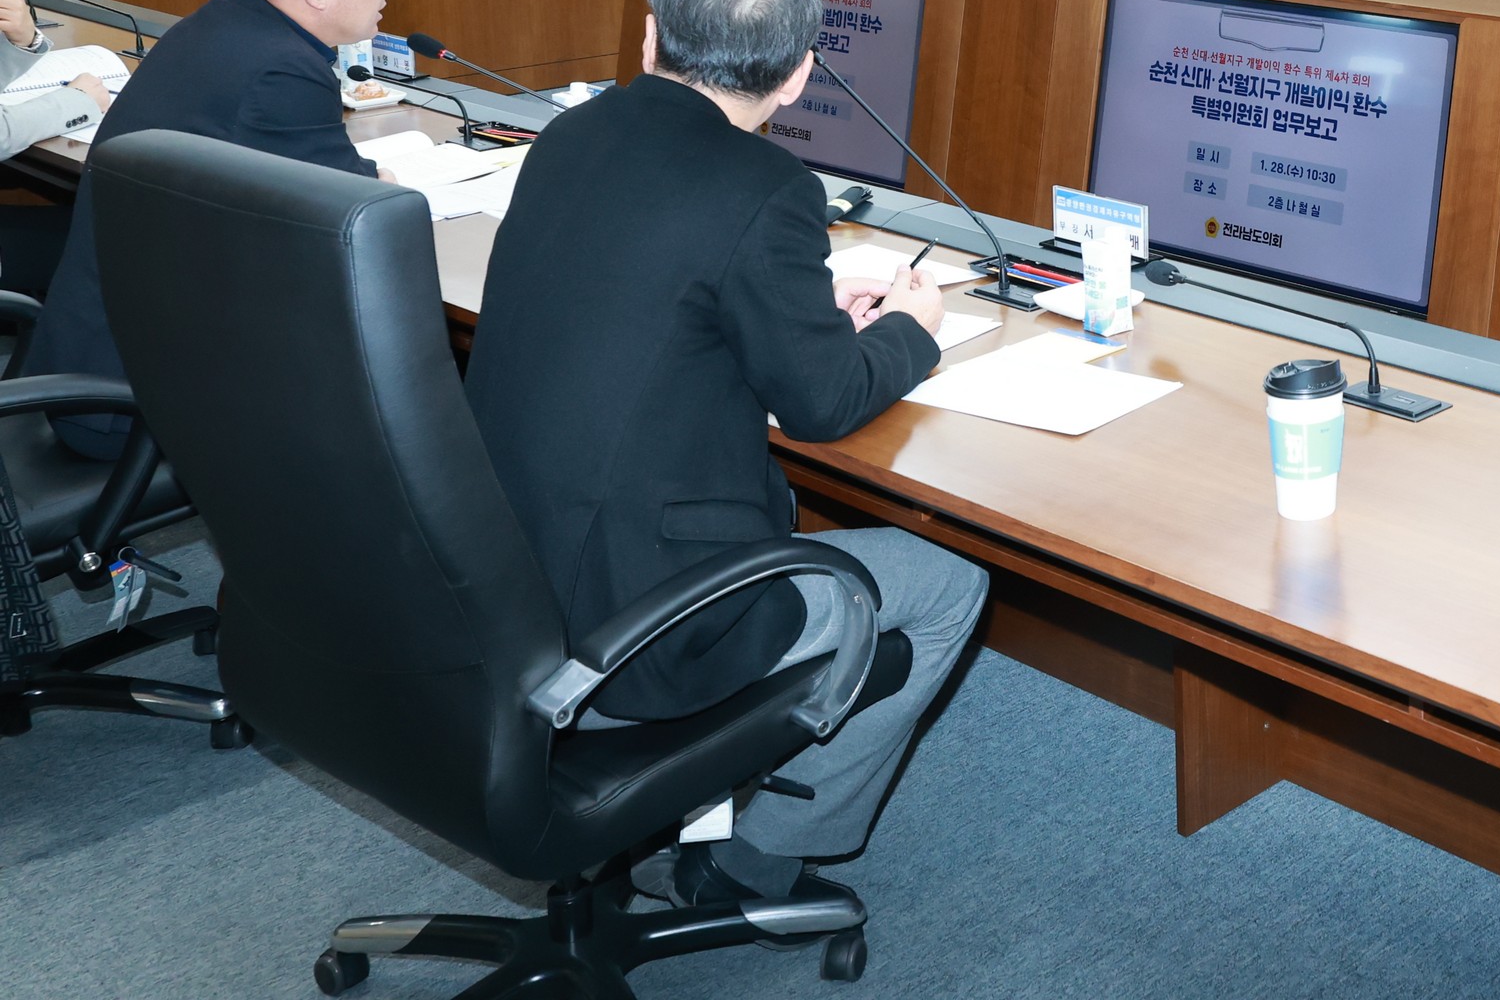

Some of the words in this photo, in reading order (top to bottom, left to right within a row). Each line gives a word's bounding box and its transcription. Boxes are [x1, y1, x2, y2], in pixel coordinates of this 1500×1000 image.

[860, 13, 883, 35] 환수
[817, 31, 850, 54] 무보고
[1173, 46, 1189, 59] 순천
[1246, 57, 1280, 73] 개발이익
[1283, 62, 1301, 76] 환수
[1304, 65, 1322, 80] 특위
[1325, 69, 1349, 84] 제4차
[1352, 74, 1371, 87] 회의
[1149, 60, 1178, 85] 순천
[1284, 81, 1350, 114] 개발이익
[1353, 92, 1388, 119] 환수
[1191, 95, 1269, 129] 특별위원회
[1272, 109, 1338, 141] 업무보고
[771, 122, 812, 141] 전라남도의회
[1306, 168, 1336, 185] 10:30
[1268, 196, 1284, 210] 2층
[1222, 222, 1283, 249] 전라남도의회
